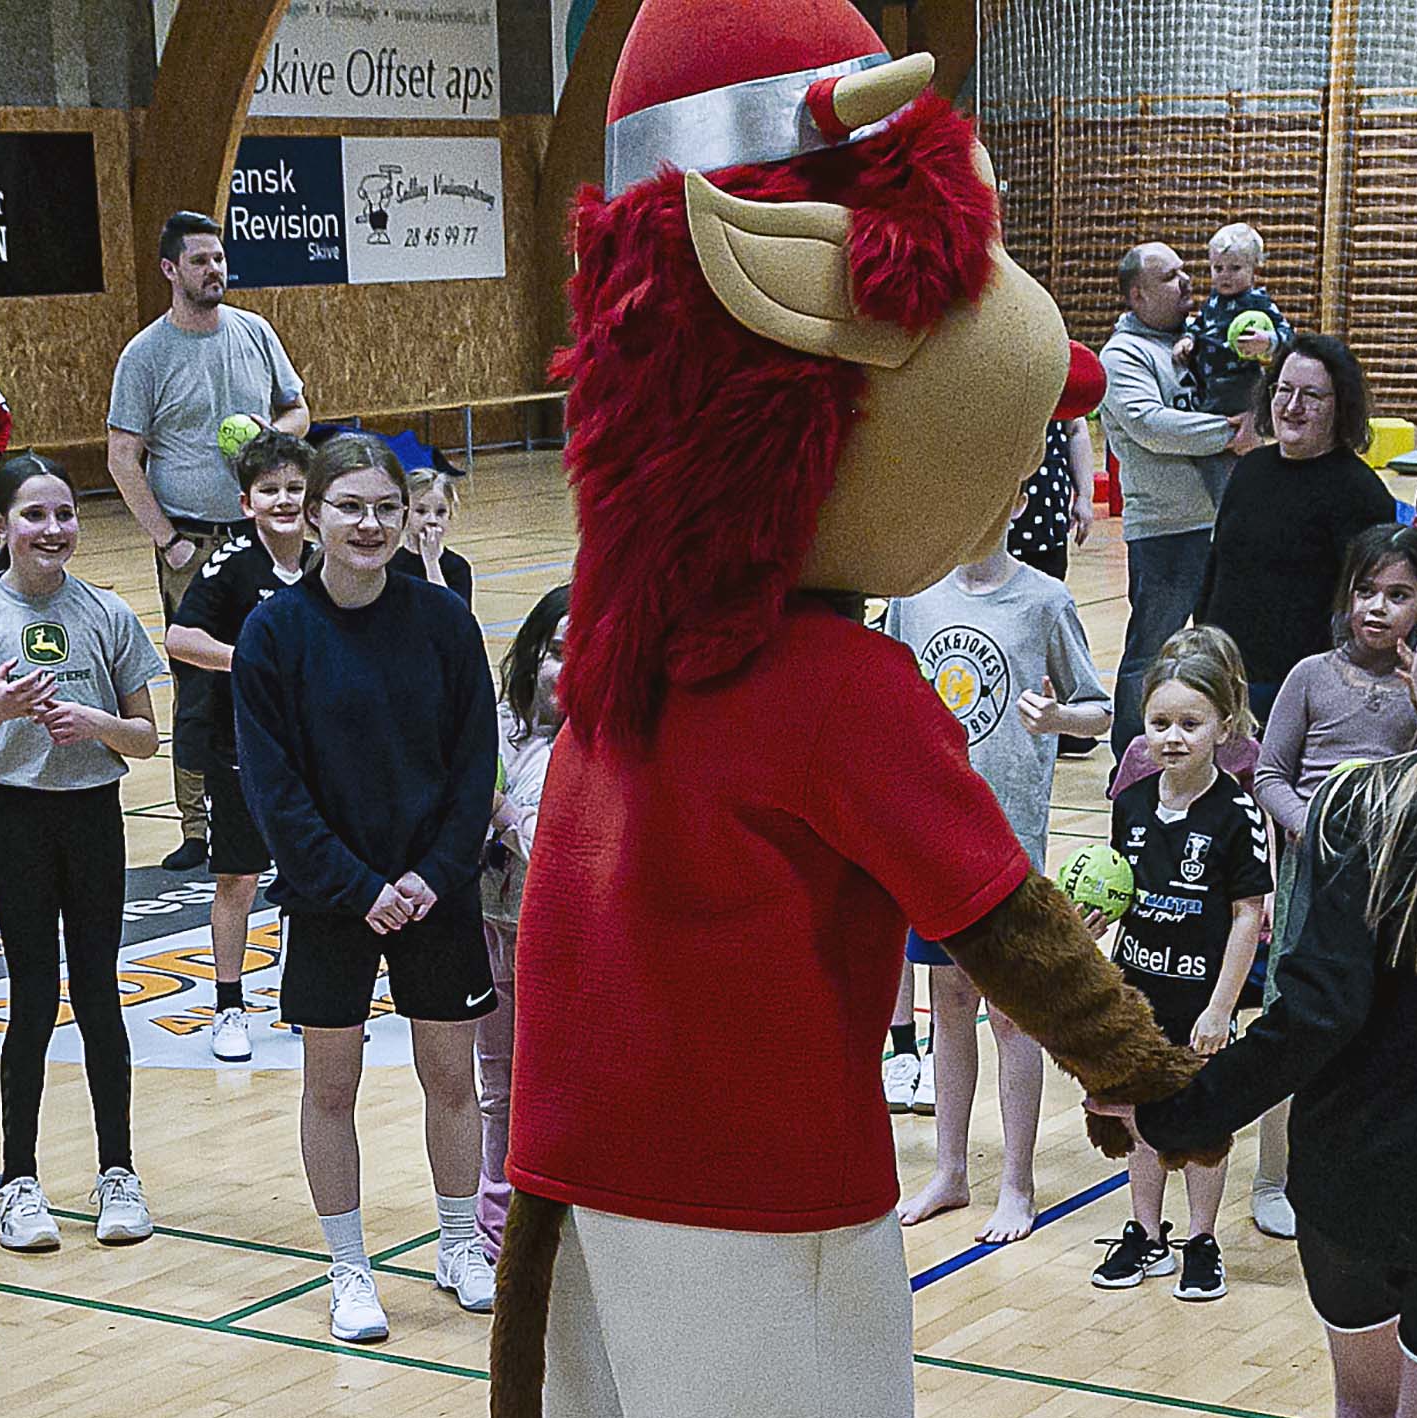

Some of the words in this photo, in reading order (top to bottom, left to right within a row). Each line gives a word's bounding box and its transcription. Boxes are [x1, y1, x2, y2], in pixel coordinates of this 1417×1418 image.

[346, 47, 436, 99] Offset
[445, 63, 495, 113] aps
[232, 159, 296, 195] ansk
[231, 204, 339, 241] Revision
[404, 227, 420, 248] 28
[444, 226, 459, 245] 99
[462, 226, 478, 246] 77
[308, 242, 340, 261] Skive
[1123, 935, 1171, 973] Steel
[1177, 955, 1206, 976] as
